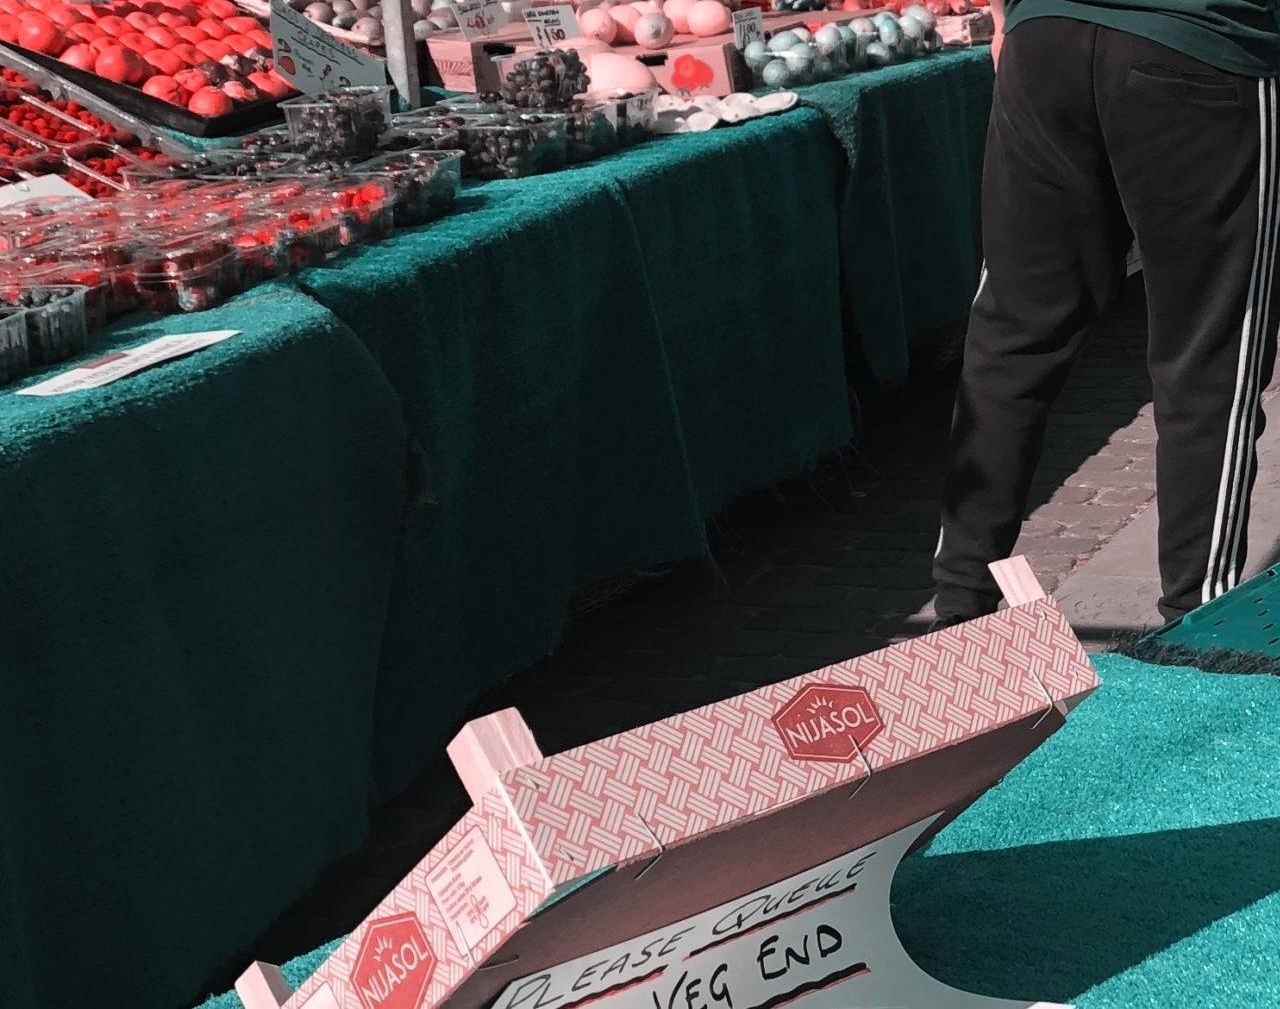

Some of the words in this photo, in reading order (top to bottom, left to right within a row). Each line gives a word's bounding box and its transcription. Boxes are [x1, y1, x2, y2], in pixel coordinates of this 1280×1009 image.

[785, 702, 876, 749] NIJASOL
[507, 925, 696, 1009] PLEASE
[711, 851, 878, 936] QUEUE
[651, 962, 733, 1009] VEG
[757, 923, 843, 983] END
[360, 935, 429, 1004] NIJASOL
